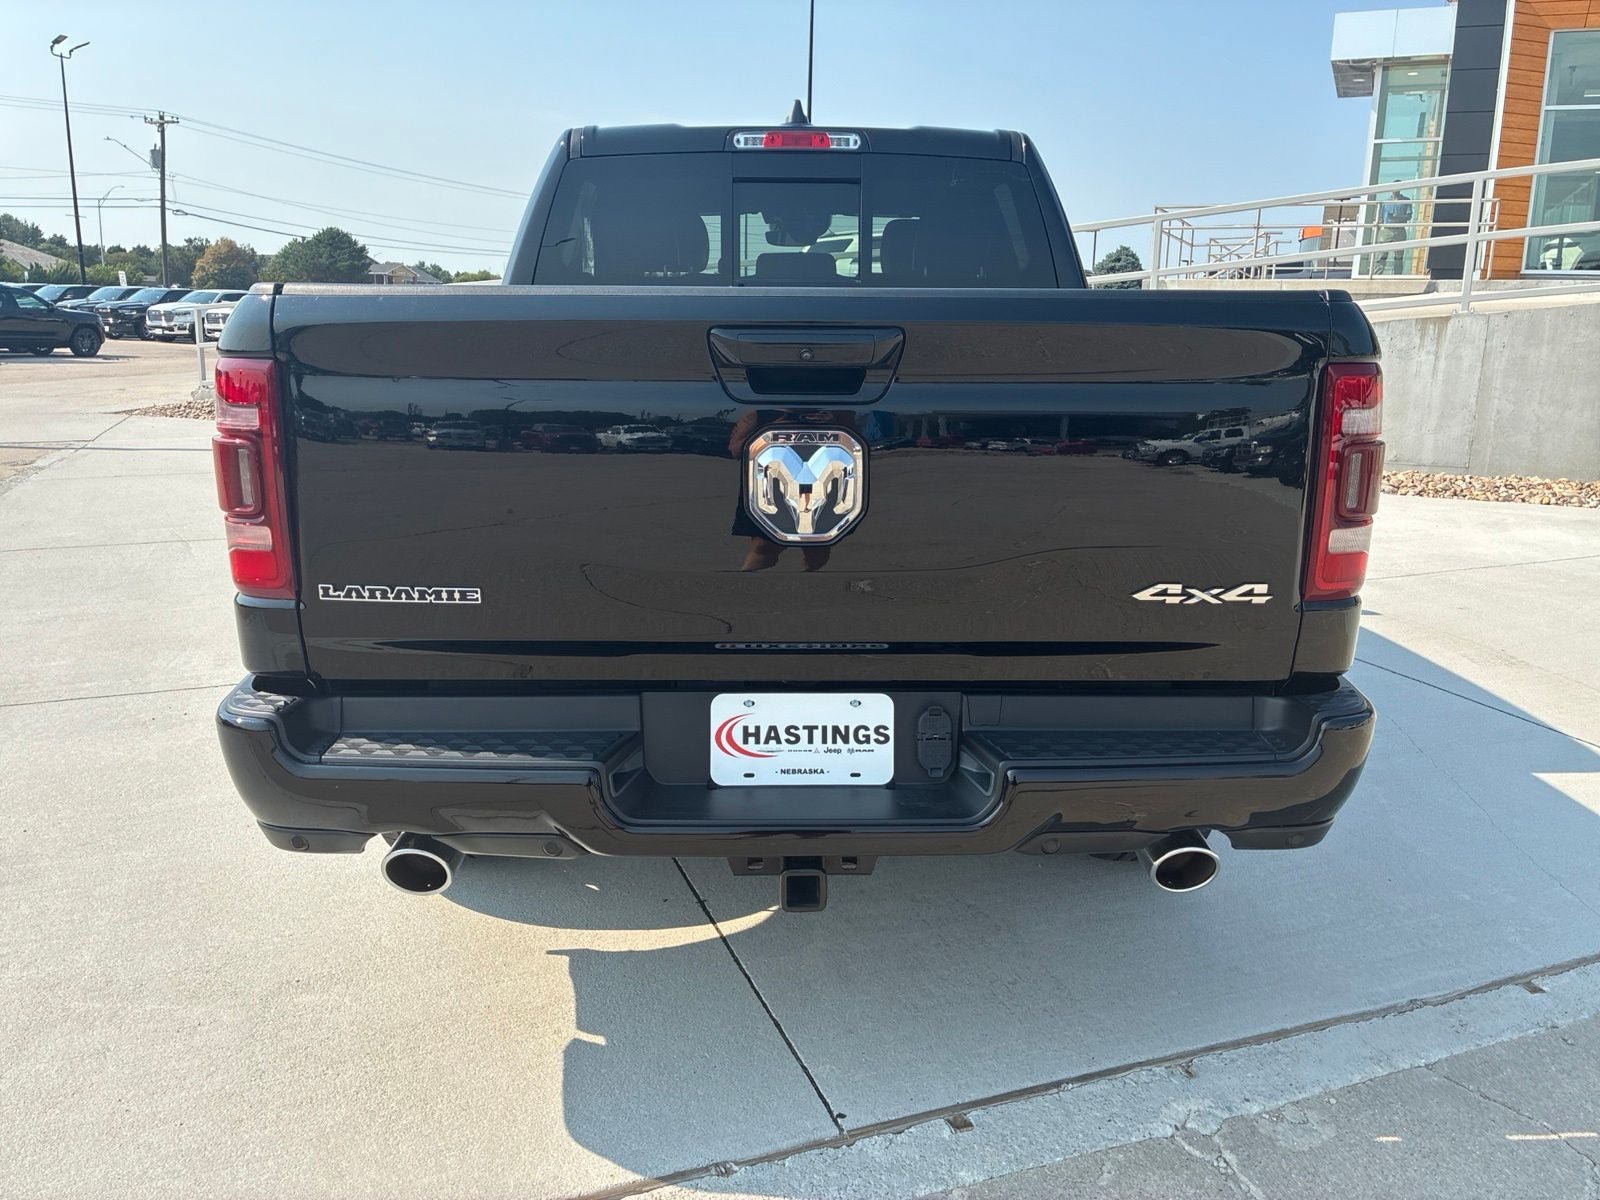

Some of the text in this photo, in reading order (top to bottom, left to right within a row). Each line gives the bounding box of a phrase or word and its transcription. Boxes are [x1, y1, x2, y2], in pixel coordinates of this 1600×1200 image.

[771, 432, 839, 442] RAM
[318, 584, 481, 603] LARAMIE
[1131, 583, 1274, 604] 4x4
[742, 725, 891, 745] HASTINGS
